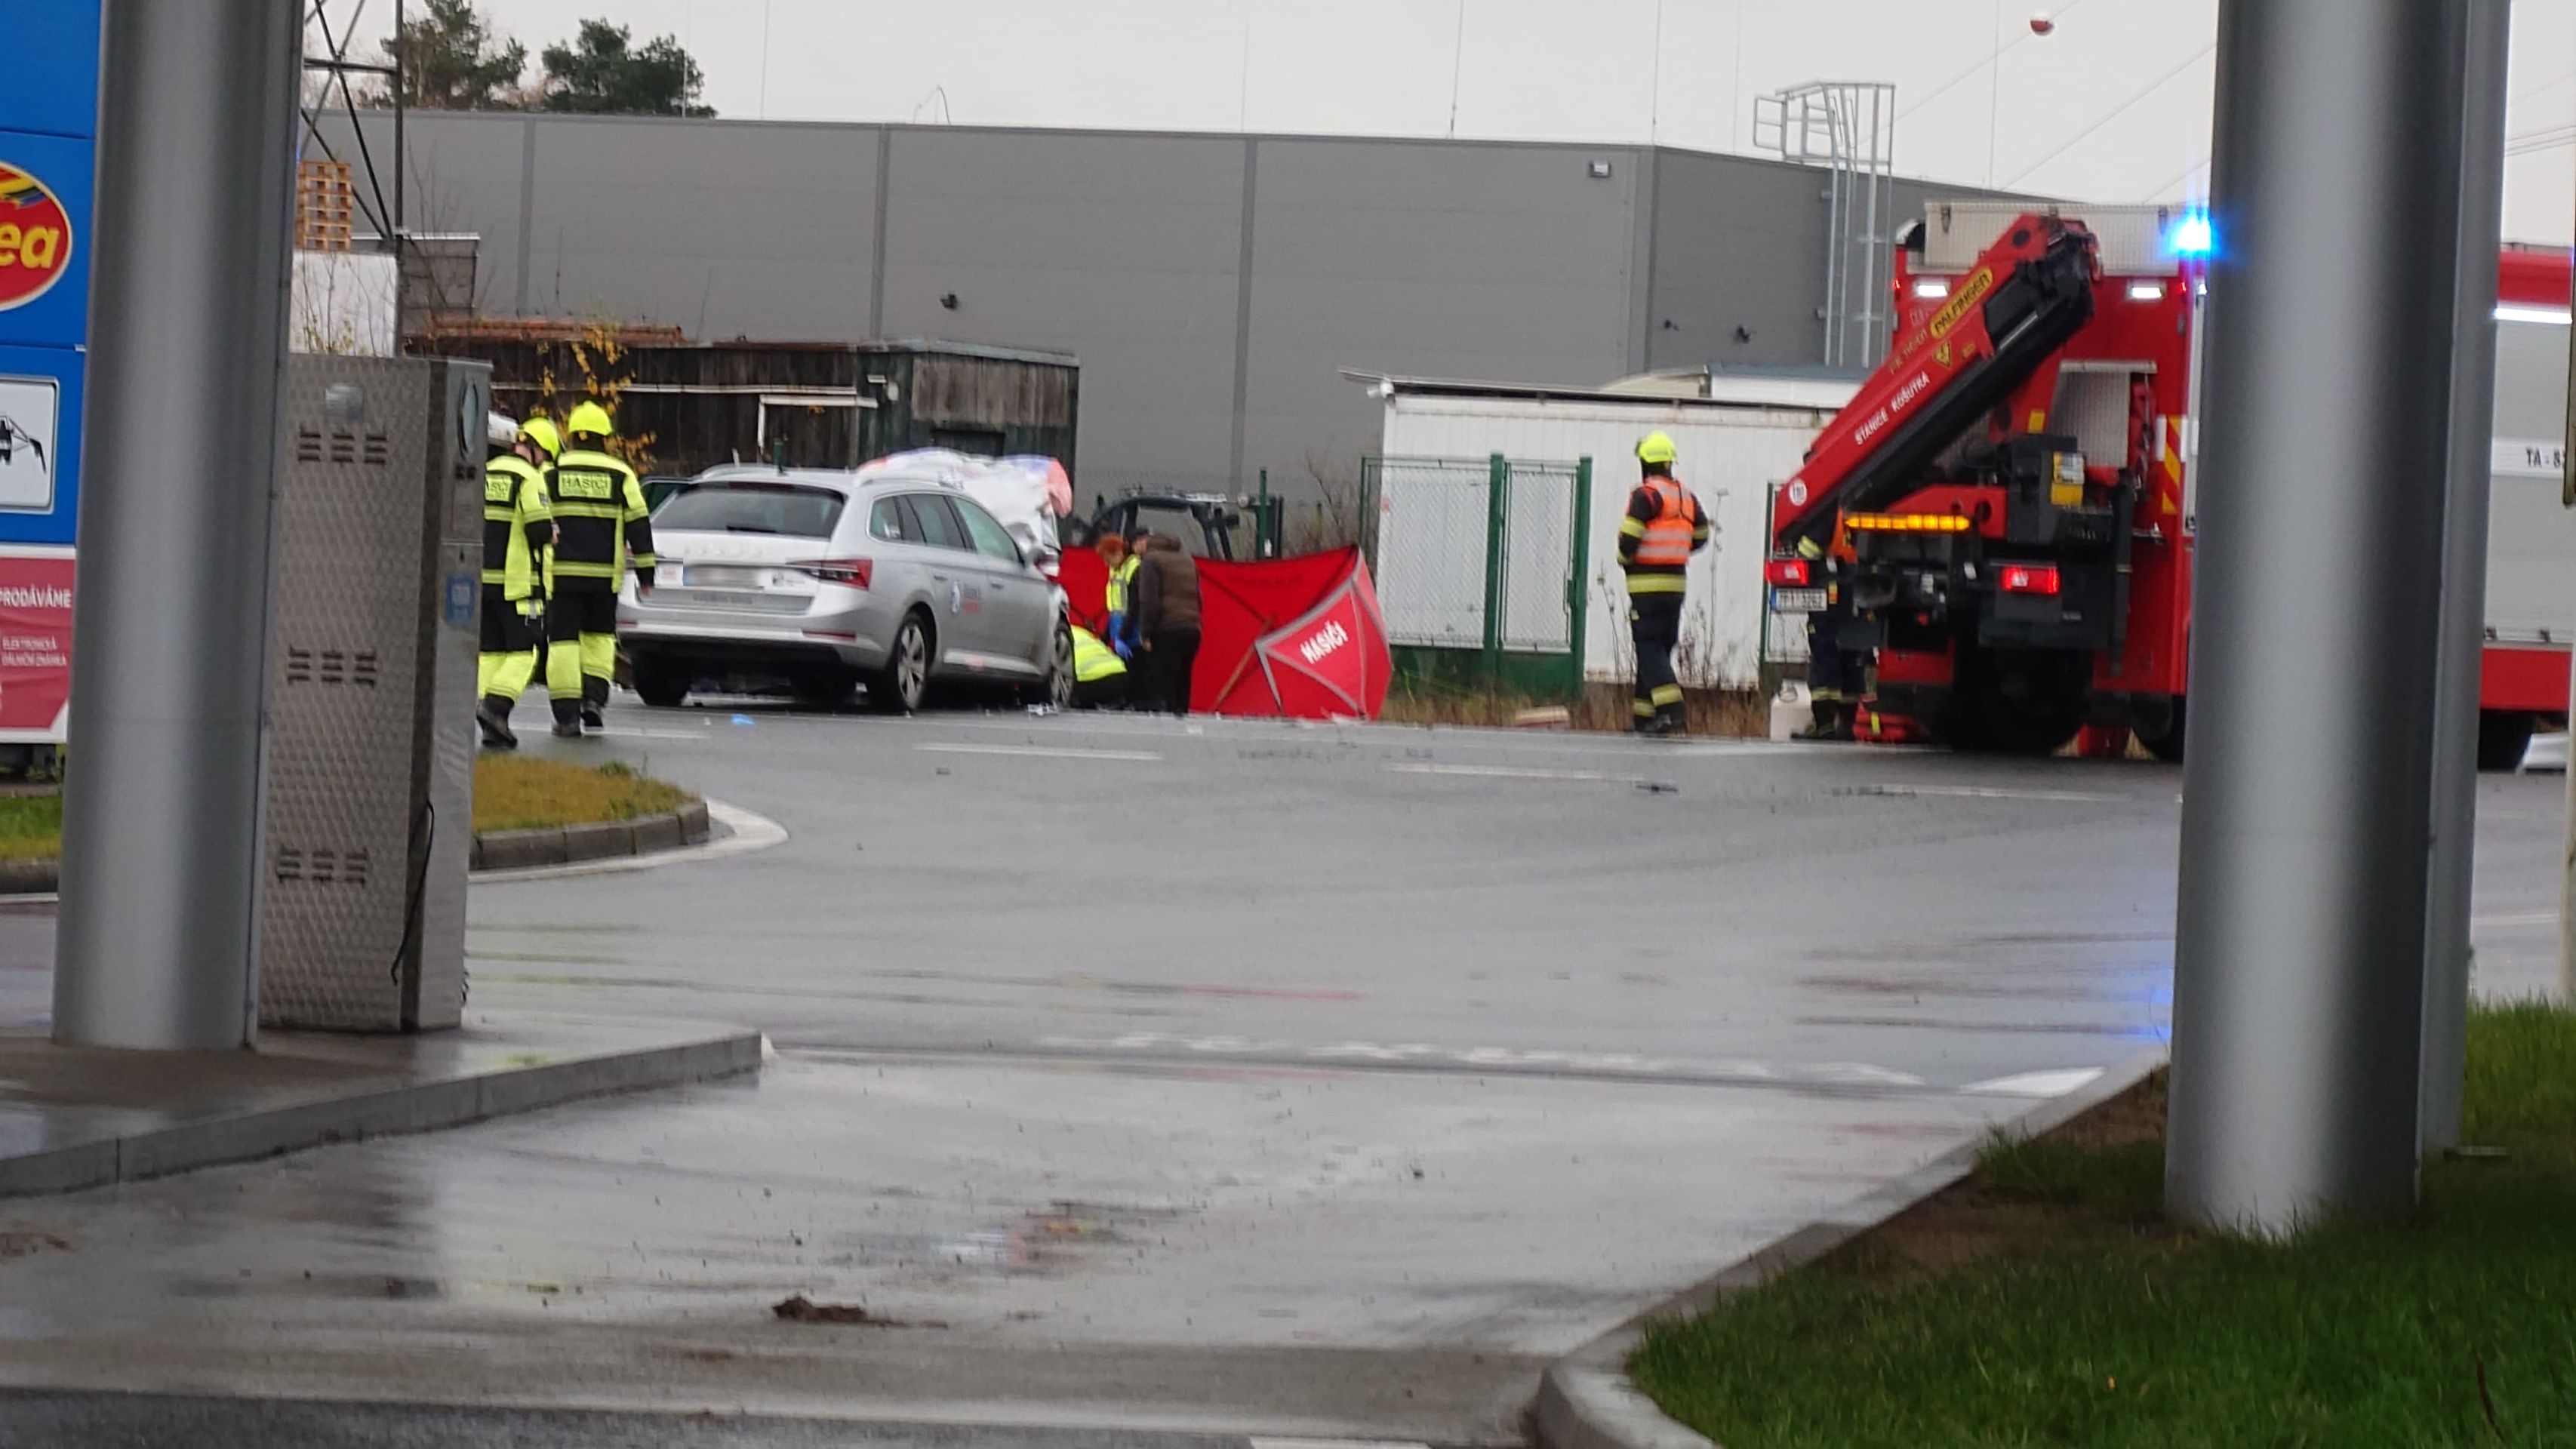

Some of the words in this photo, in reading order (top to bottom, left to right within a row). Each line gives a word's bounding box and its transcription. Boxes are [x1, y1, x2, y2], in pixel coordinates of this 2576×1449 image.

[1934, 272, 1990, 335] PALFINGER
[1855, 408, 1888, 445] STANICE
[1891, 371, 1930, 411] KOŠUTKA
[1300, 620, 1349, 664] HASIČI
